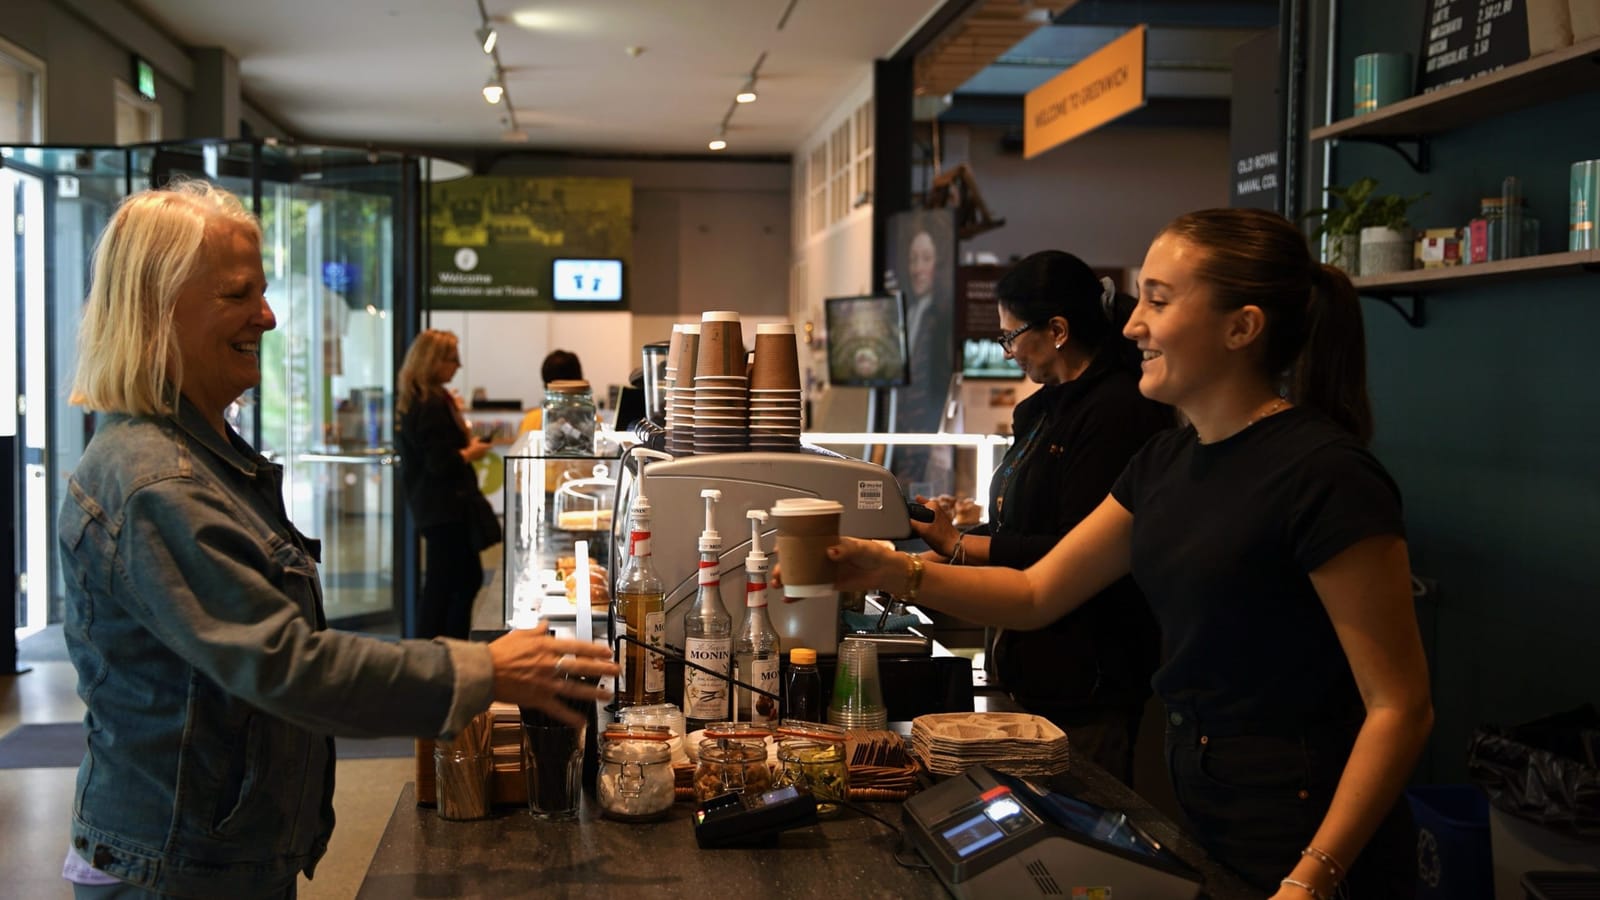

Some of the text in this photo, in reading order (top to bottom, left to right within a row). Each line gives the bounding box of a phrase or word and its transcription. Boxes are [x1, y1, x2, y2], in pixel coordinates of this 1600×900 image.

[1035, 97, 1067, 128] WELCOME
[1080, 64, 1129, 105] GREENWICH
[1237, 158, 1253, 174] OLD
[1237, 179, 1261, 194] NAVAL
[438, 272, 493, 285] Welcome
[485, 286, 503, 296] and
[504, 285, 539, 296] Tickets
[690, 650, 729, 660] MONIN
